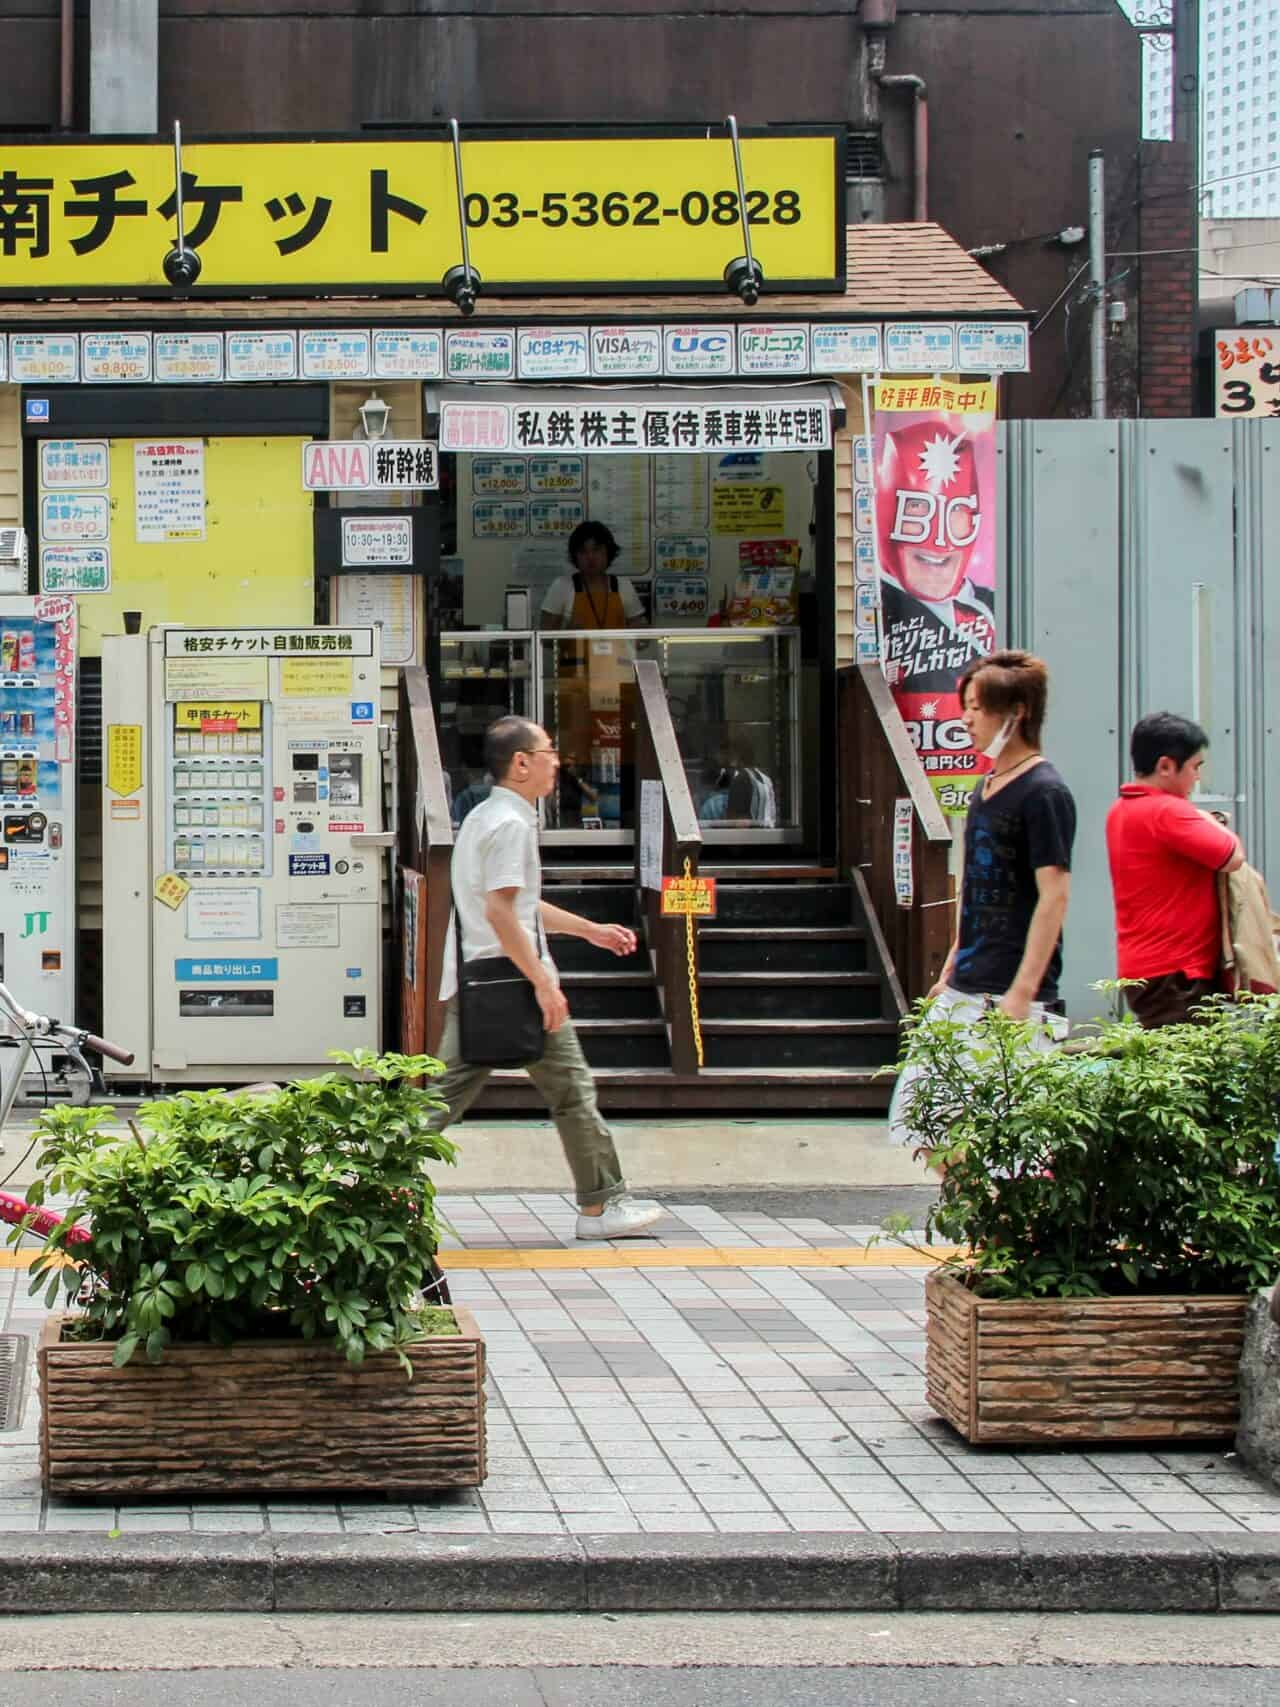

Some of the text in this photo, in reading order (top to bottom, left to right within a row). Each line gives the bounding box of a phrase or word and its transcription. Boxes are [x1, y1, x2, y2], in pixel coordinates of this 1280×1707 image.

[465, 190, 801, 228] 03-5362-0828
[524, 339, 585, 356] JCBギフト
[596, 337, 656, 354] VISAギフト
[671, 337, 727, 353] UC
[743, 335, 804, 353] UFJニコス
[881, 386, 987, 411] 好評販売中!
[310, 447, 366, 485] ANA
[376, 447, 434, 484] 新幹線
[889, 489, 982, 547] BIG
[184, 634, 353, 652] 格安チケット自動販売機
[20, 911, 52, 939] JT
[191, 964, 262, 976] 商品取り出し口
